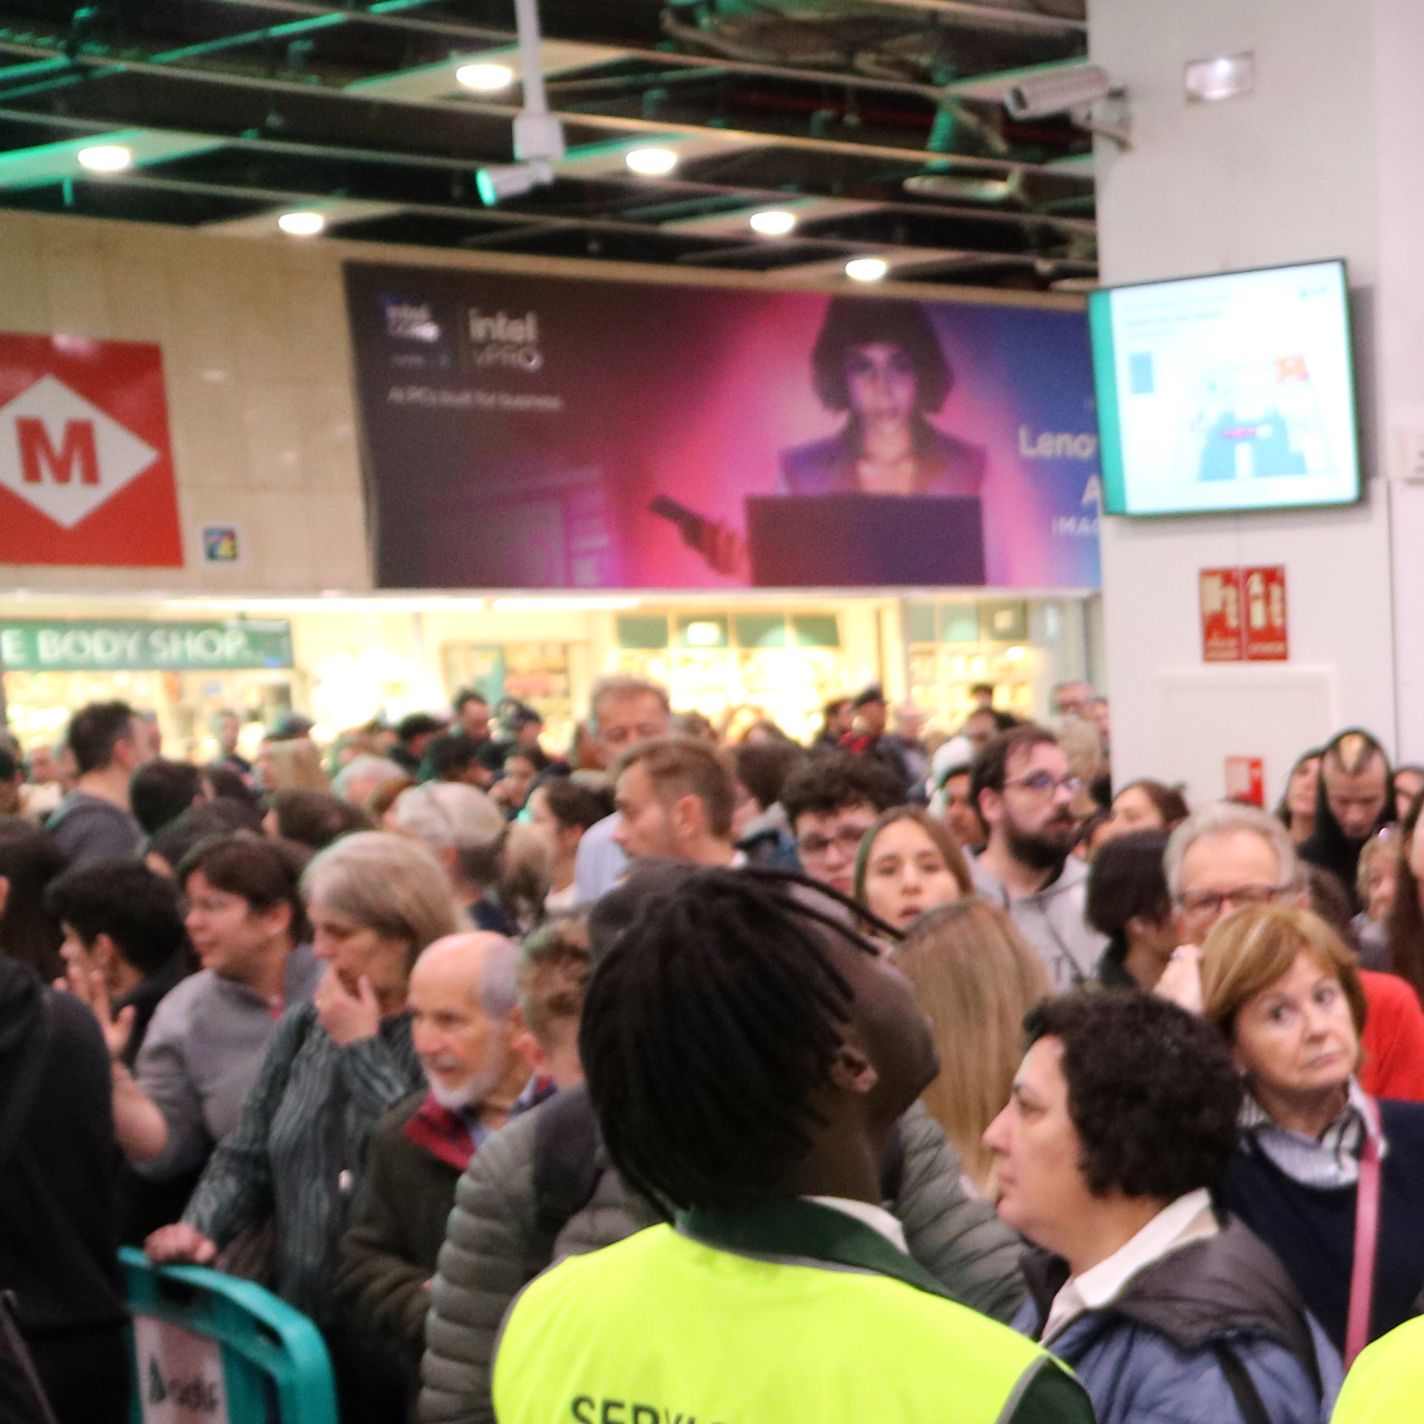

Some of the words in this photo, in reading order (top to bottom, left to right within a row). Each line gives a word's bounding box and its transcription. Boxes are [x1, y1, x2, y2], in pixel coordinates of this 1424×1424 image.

[469, 308, 537, 344] intel
[16, 417, 99, 487] M
[37, 629, 142, 663] BODY
[150, 628, 247, 663] SHOP
